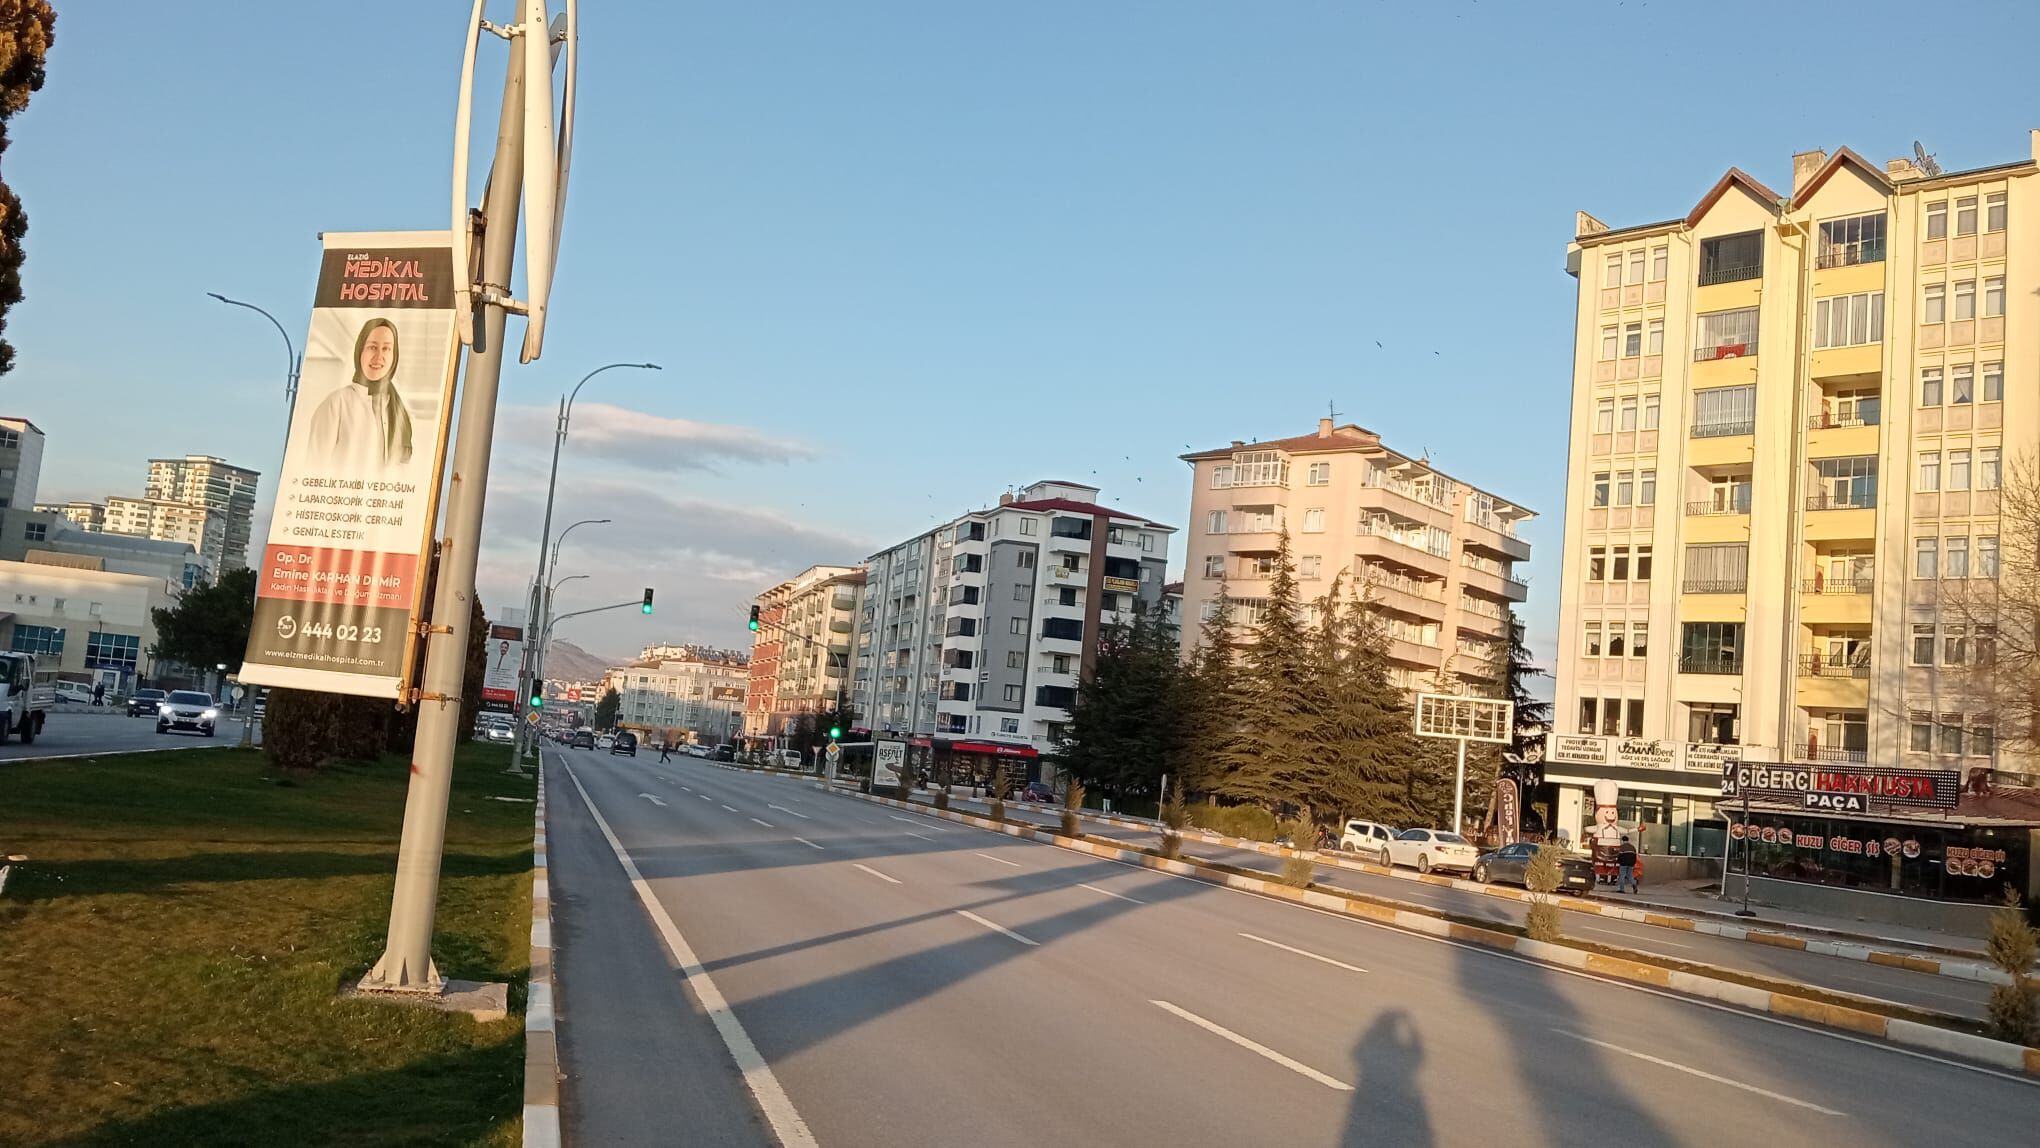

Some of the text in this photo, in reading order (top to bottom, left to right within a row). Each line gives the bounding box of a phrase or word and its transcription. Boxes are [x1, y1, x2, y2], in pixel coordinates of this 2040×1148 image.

[344, 256, 424, 278] MEDİKAL
[340, 283, 429, 301] HOSPITAL
[301, 477, 415, 493] GEBELİK TAKİBİ VE DOĞUM
[298, 493, 404, 510] LAPAROSKOPİK CERRAHİ
[295, 509, 403, 526] HİSTEROSKOPİK CERRAHİ
[292, 525, 331, 538] GENİTAL
[276, 551, 296, 565] Op.
[273, 567, 309, 580] Emine
[301, 621, 382, 643] 444 02 23
[1725, 763, 1734, 776] 7
[1721, 779, 1735, 793] 24
[1883, 775, 1935, 798] USTA
[1806, 793, 1860, 811] PAÇA
[1796, 834, 1824, 850] KUZU
